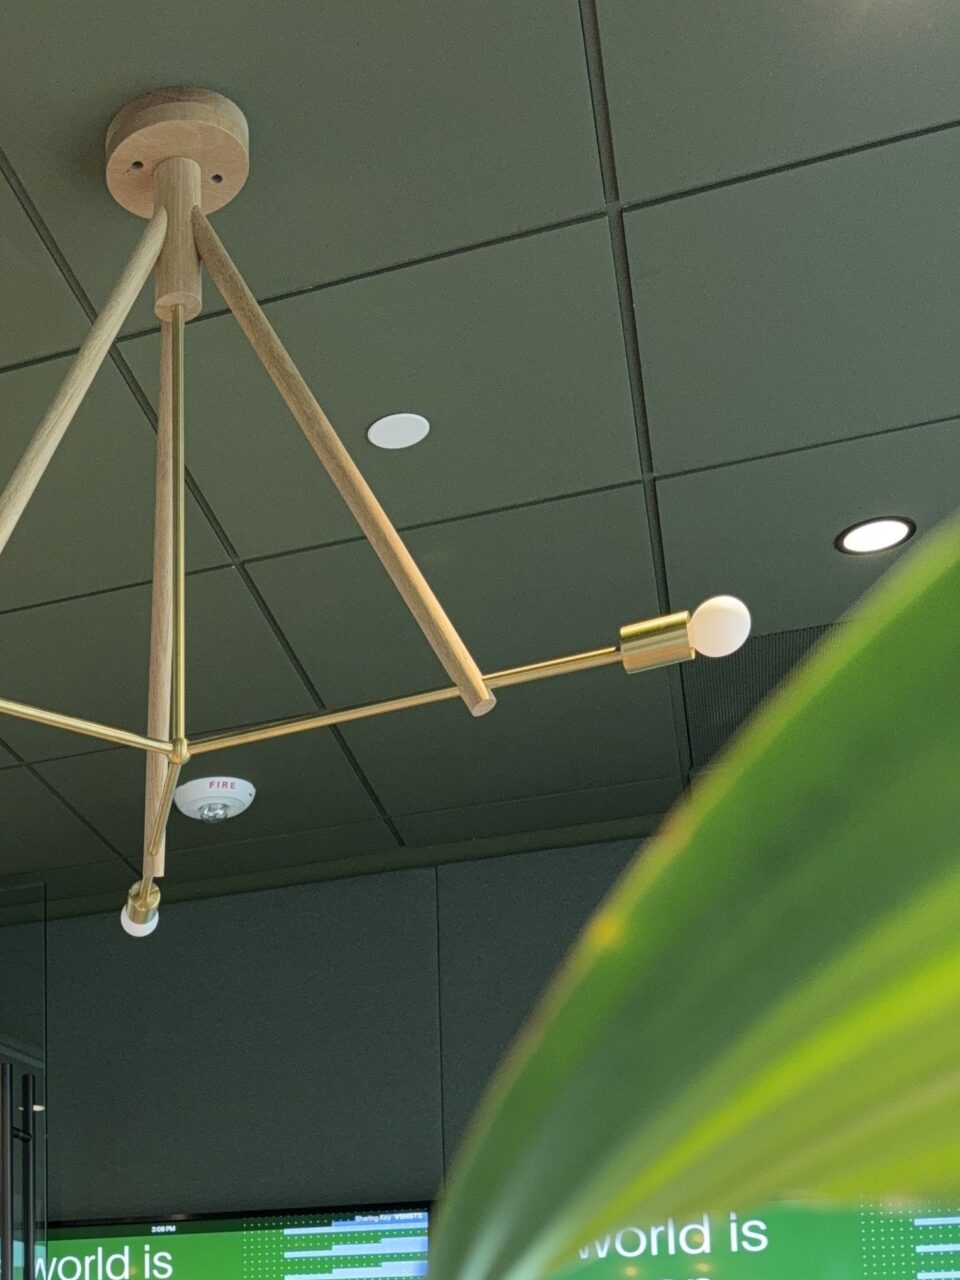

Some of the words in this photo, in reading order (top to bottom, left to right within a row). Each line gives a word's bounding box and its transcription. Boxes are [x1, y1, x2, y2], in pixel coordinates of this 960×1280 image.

[209, 781, 236, 789] FIRE
[730, 1212, 768, 1253] is
[144, 1244, 173, 1280] is
